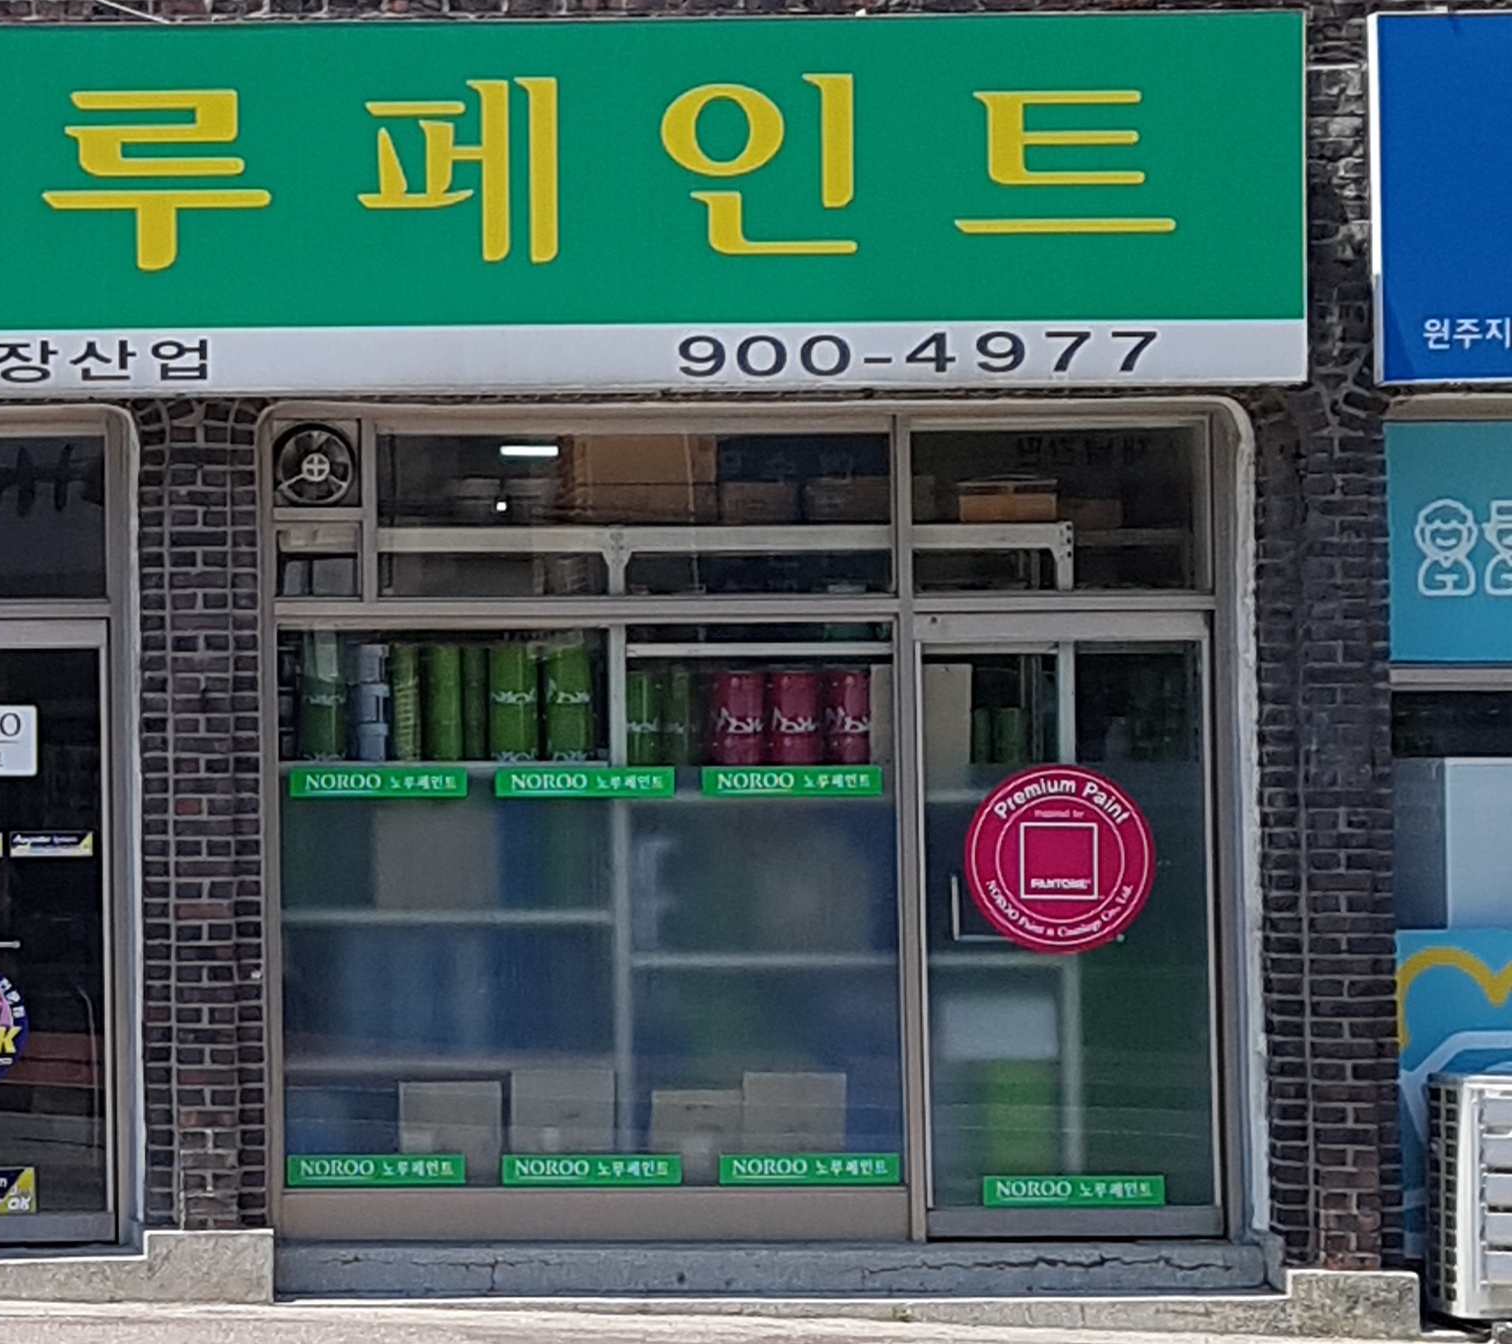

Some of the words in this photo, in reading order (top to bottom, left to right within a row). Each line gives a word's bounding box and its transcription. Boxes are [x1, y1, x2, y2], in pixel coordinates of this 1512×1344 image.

[676, 330, 1162, 378] 900-4977
[305, 773, 381, 790] NOROO
[510, 773, 588, 790] NOROO
[717, 772, 795, 789] NOROO
[993, 778, 1076, 820] Premium
[1081, 780, 1130, 824] Paint
[299, 1159, 374, 1176] NOROO
[514, 1159, 589, 1176] NOROO
[732, 1158, 807, 1175] NOROO
[996, 1181, 1072, 1196] NOROO
